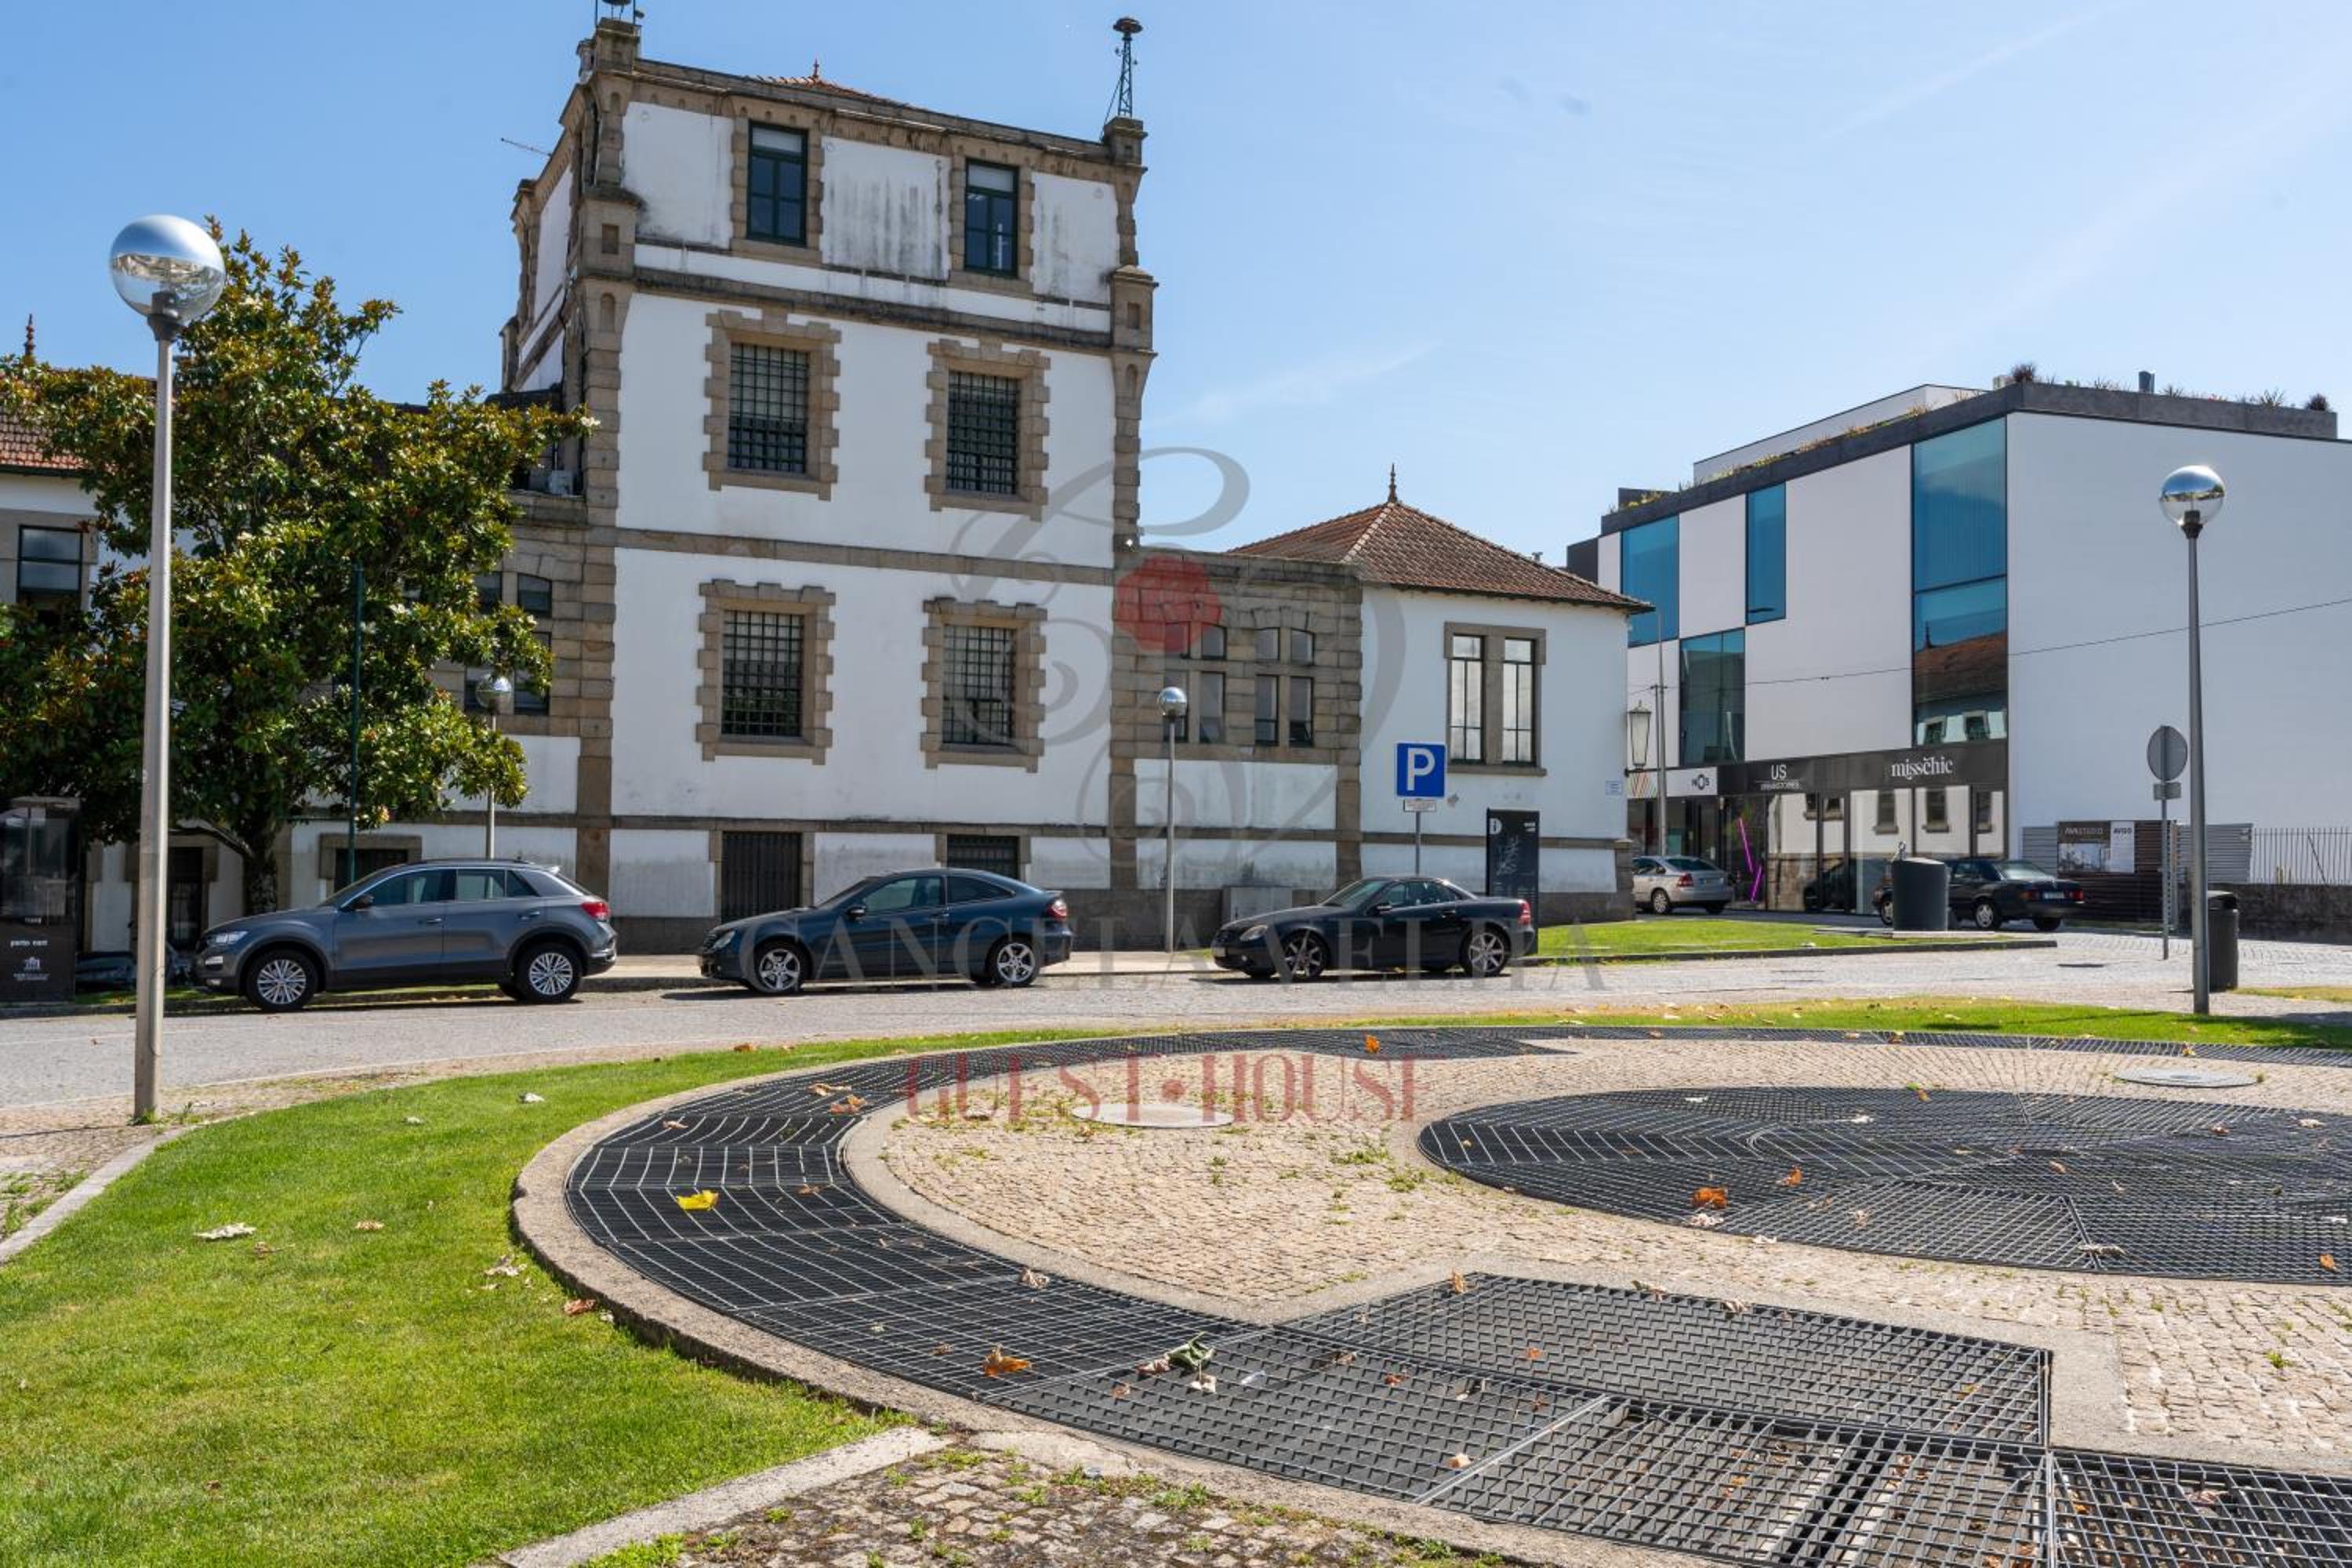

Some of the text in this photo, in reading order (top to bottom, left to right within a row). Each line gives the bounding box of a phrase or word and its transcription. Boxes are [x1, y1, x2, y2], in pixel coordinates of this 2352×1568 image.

[1407, 747, 1436, 791] P
[1771, 764, 1787, 780] US
[1691, 774, 1710, 790] NOS
